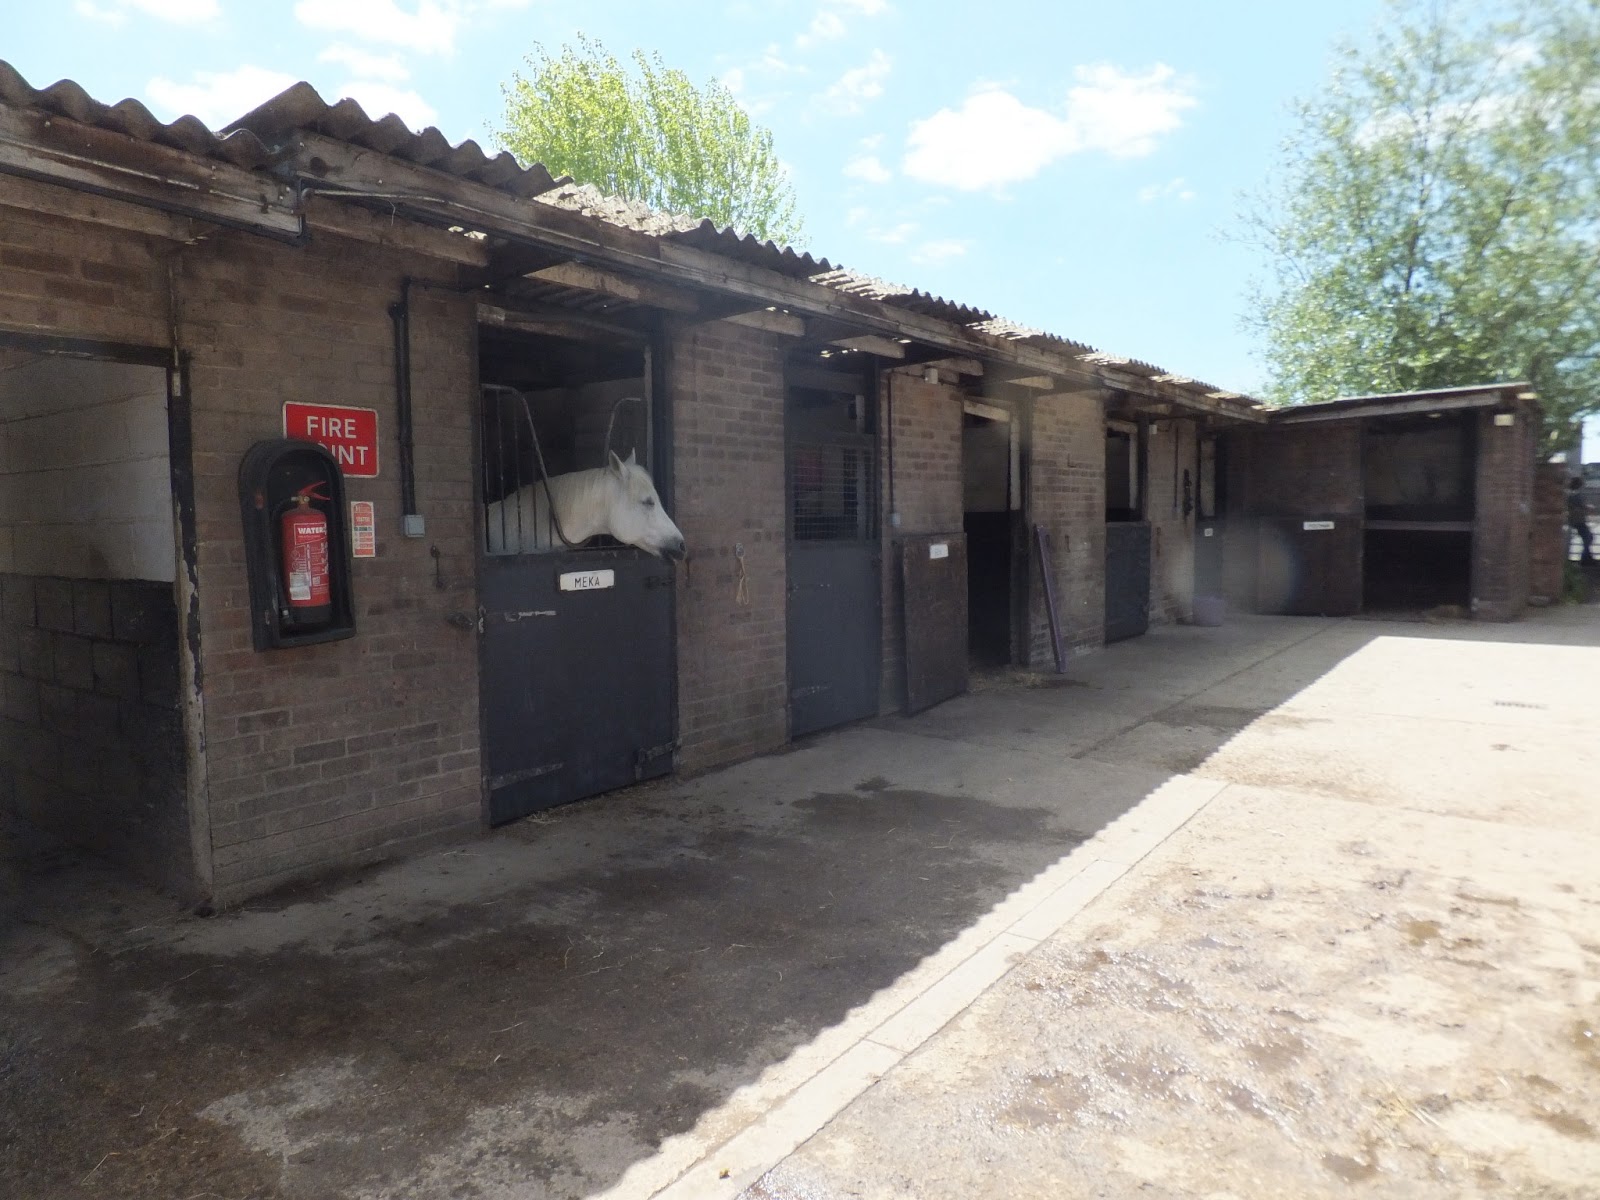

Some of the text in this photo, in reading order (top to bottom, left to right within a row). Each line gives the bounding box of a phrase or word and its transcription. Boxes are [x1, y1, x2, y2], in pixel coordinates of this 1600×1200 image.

[307, 416, 357, 438] FIRE
[317, 441, 369, 466] INT
[297, 527, 326, 535] WATER
[574, 576, 600, 588] MEKA
